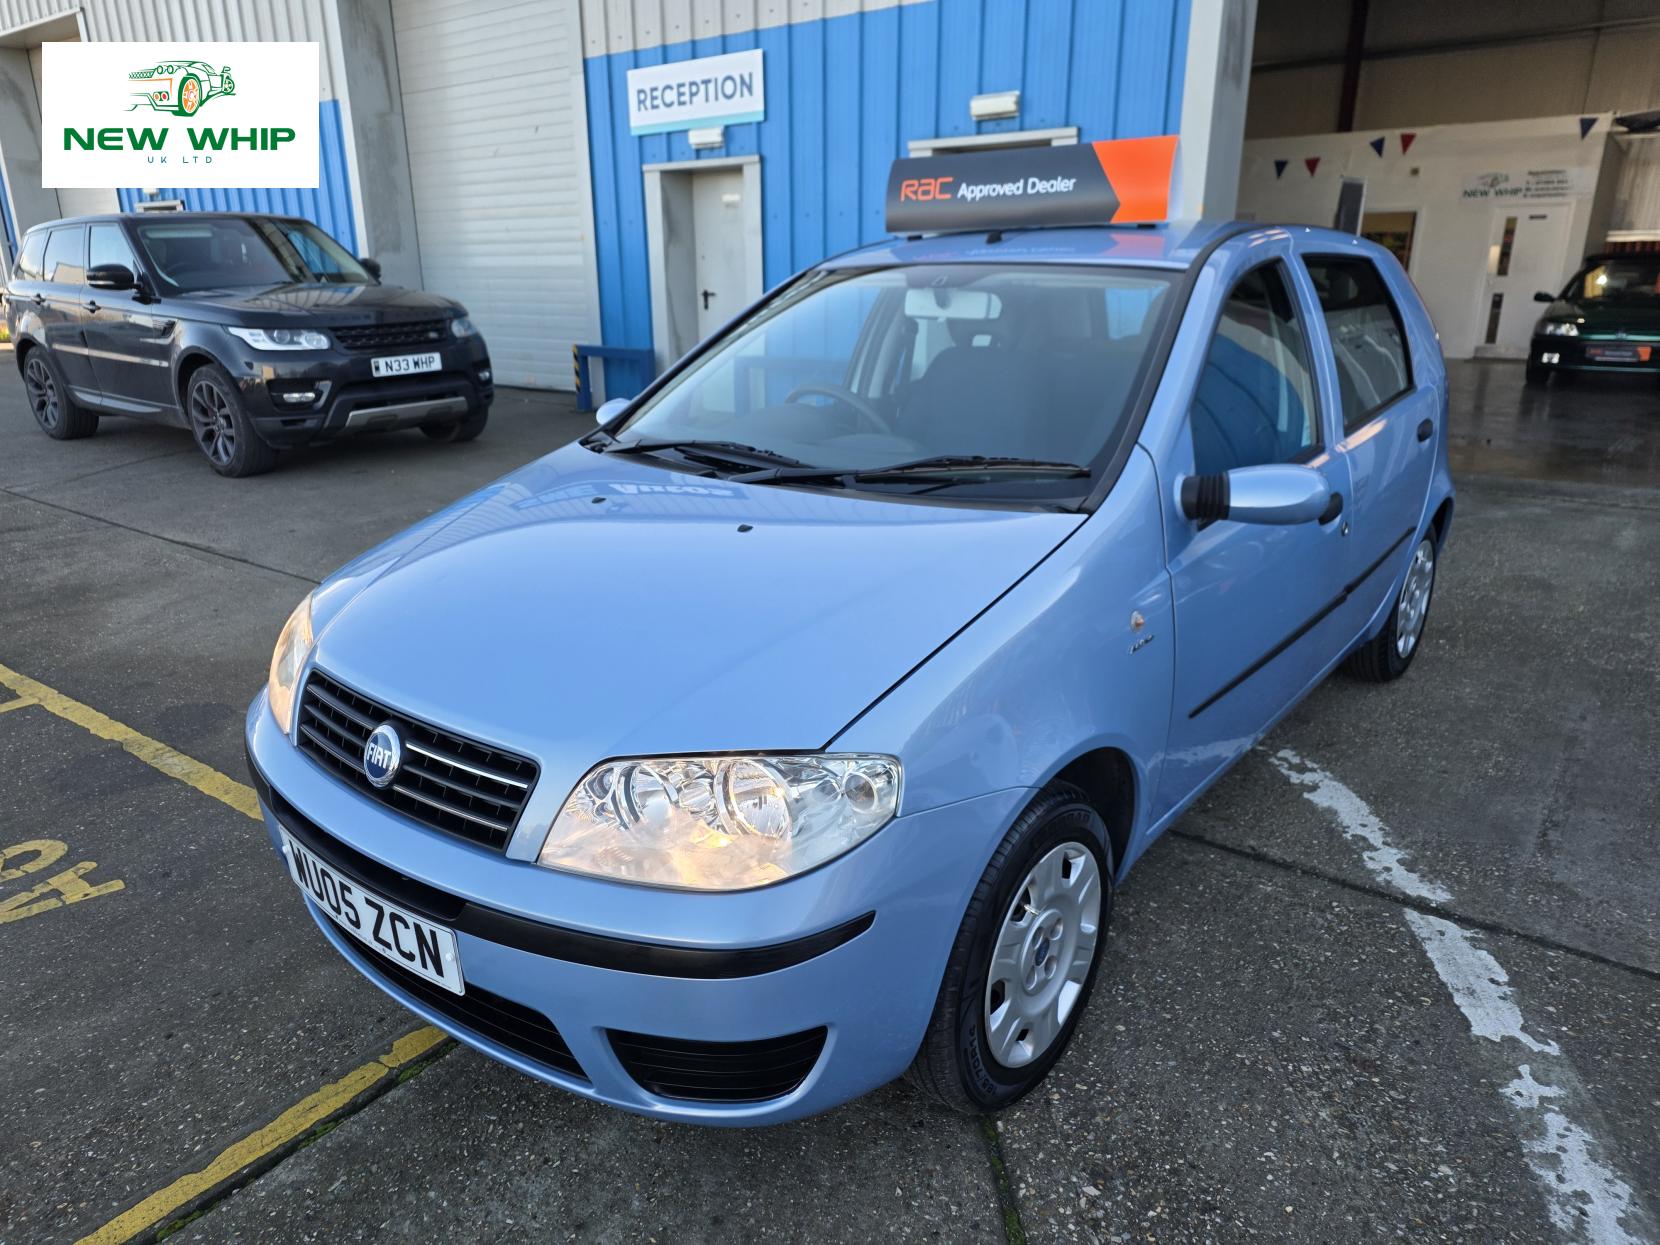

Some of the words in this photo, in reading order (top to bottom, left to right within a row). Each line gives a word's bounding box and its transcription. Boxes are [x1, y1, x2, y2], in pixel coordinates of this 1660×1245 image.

[637, 72, 753, 112] RECEPTION
[957, 179, 1024, 201] Approved
[1027, 176, 1076, 194] Dealer
[385, 359, 410, 373] N33
[413, 355, 435, 370] WHP
[367, 742, 392, 769] FIAT
[289, 839, 361, 930] WU05
[364, 896, 444, 978] ZCN
